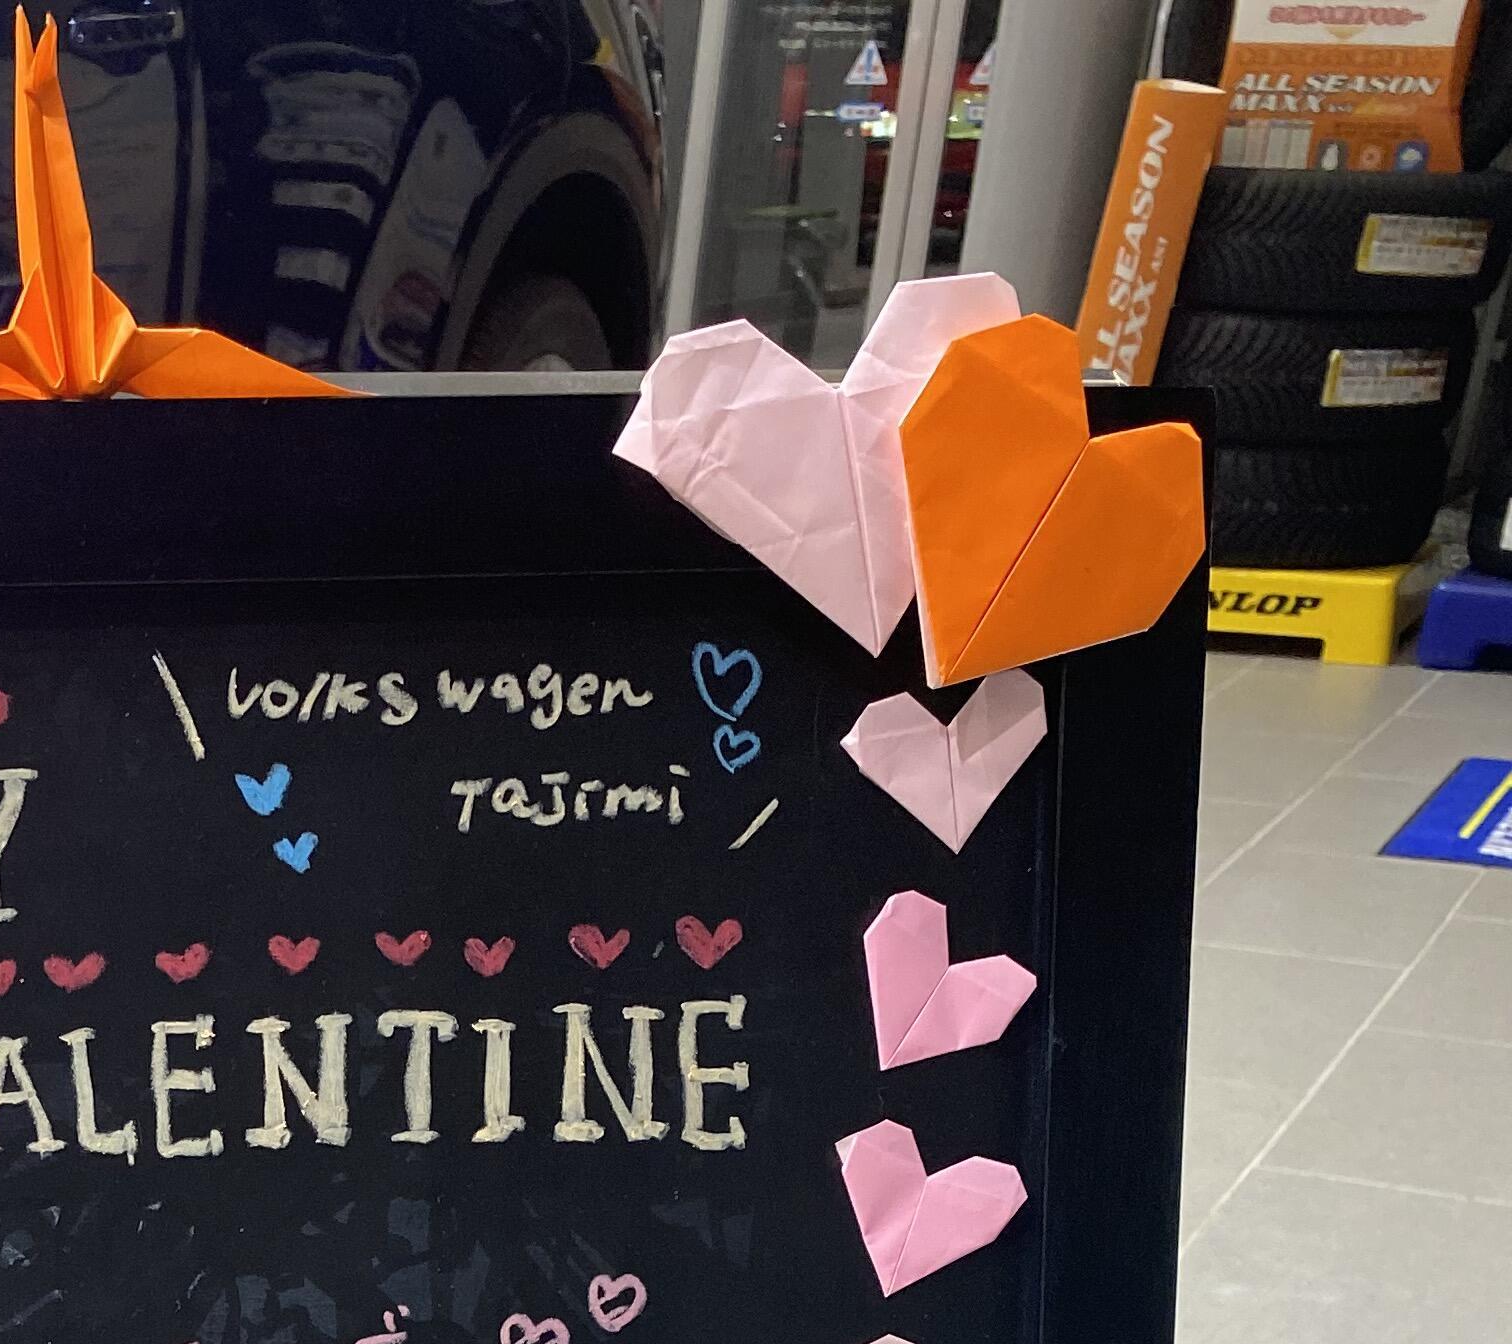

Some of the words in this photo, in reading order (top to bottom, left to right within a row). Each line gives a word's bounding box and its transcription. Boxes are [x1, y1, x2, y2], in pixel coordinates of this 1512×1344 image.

[1235, 73, 1295, 93] ALL
[1301, 72, 1442, 96] SEASON
[1107, 114, 1174, 312] SEASON
[1114, 275, 1158, 386] AXX
[1208, 589, 1324, 617] NLOP
